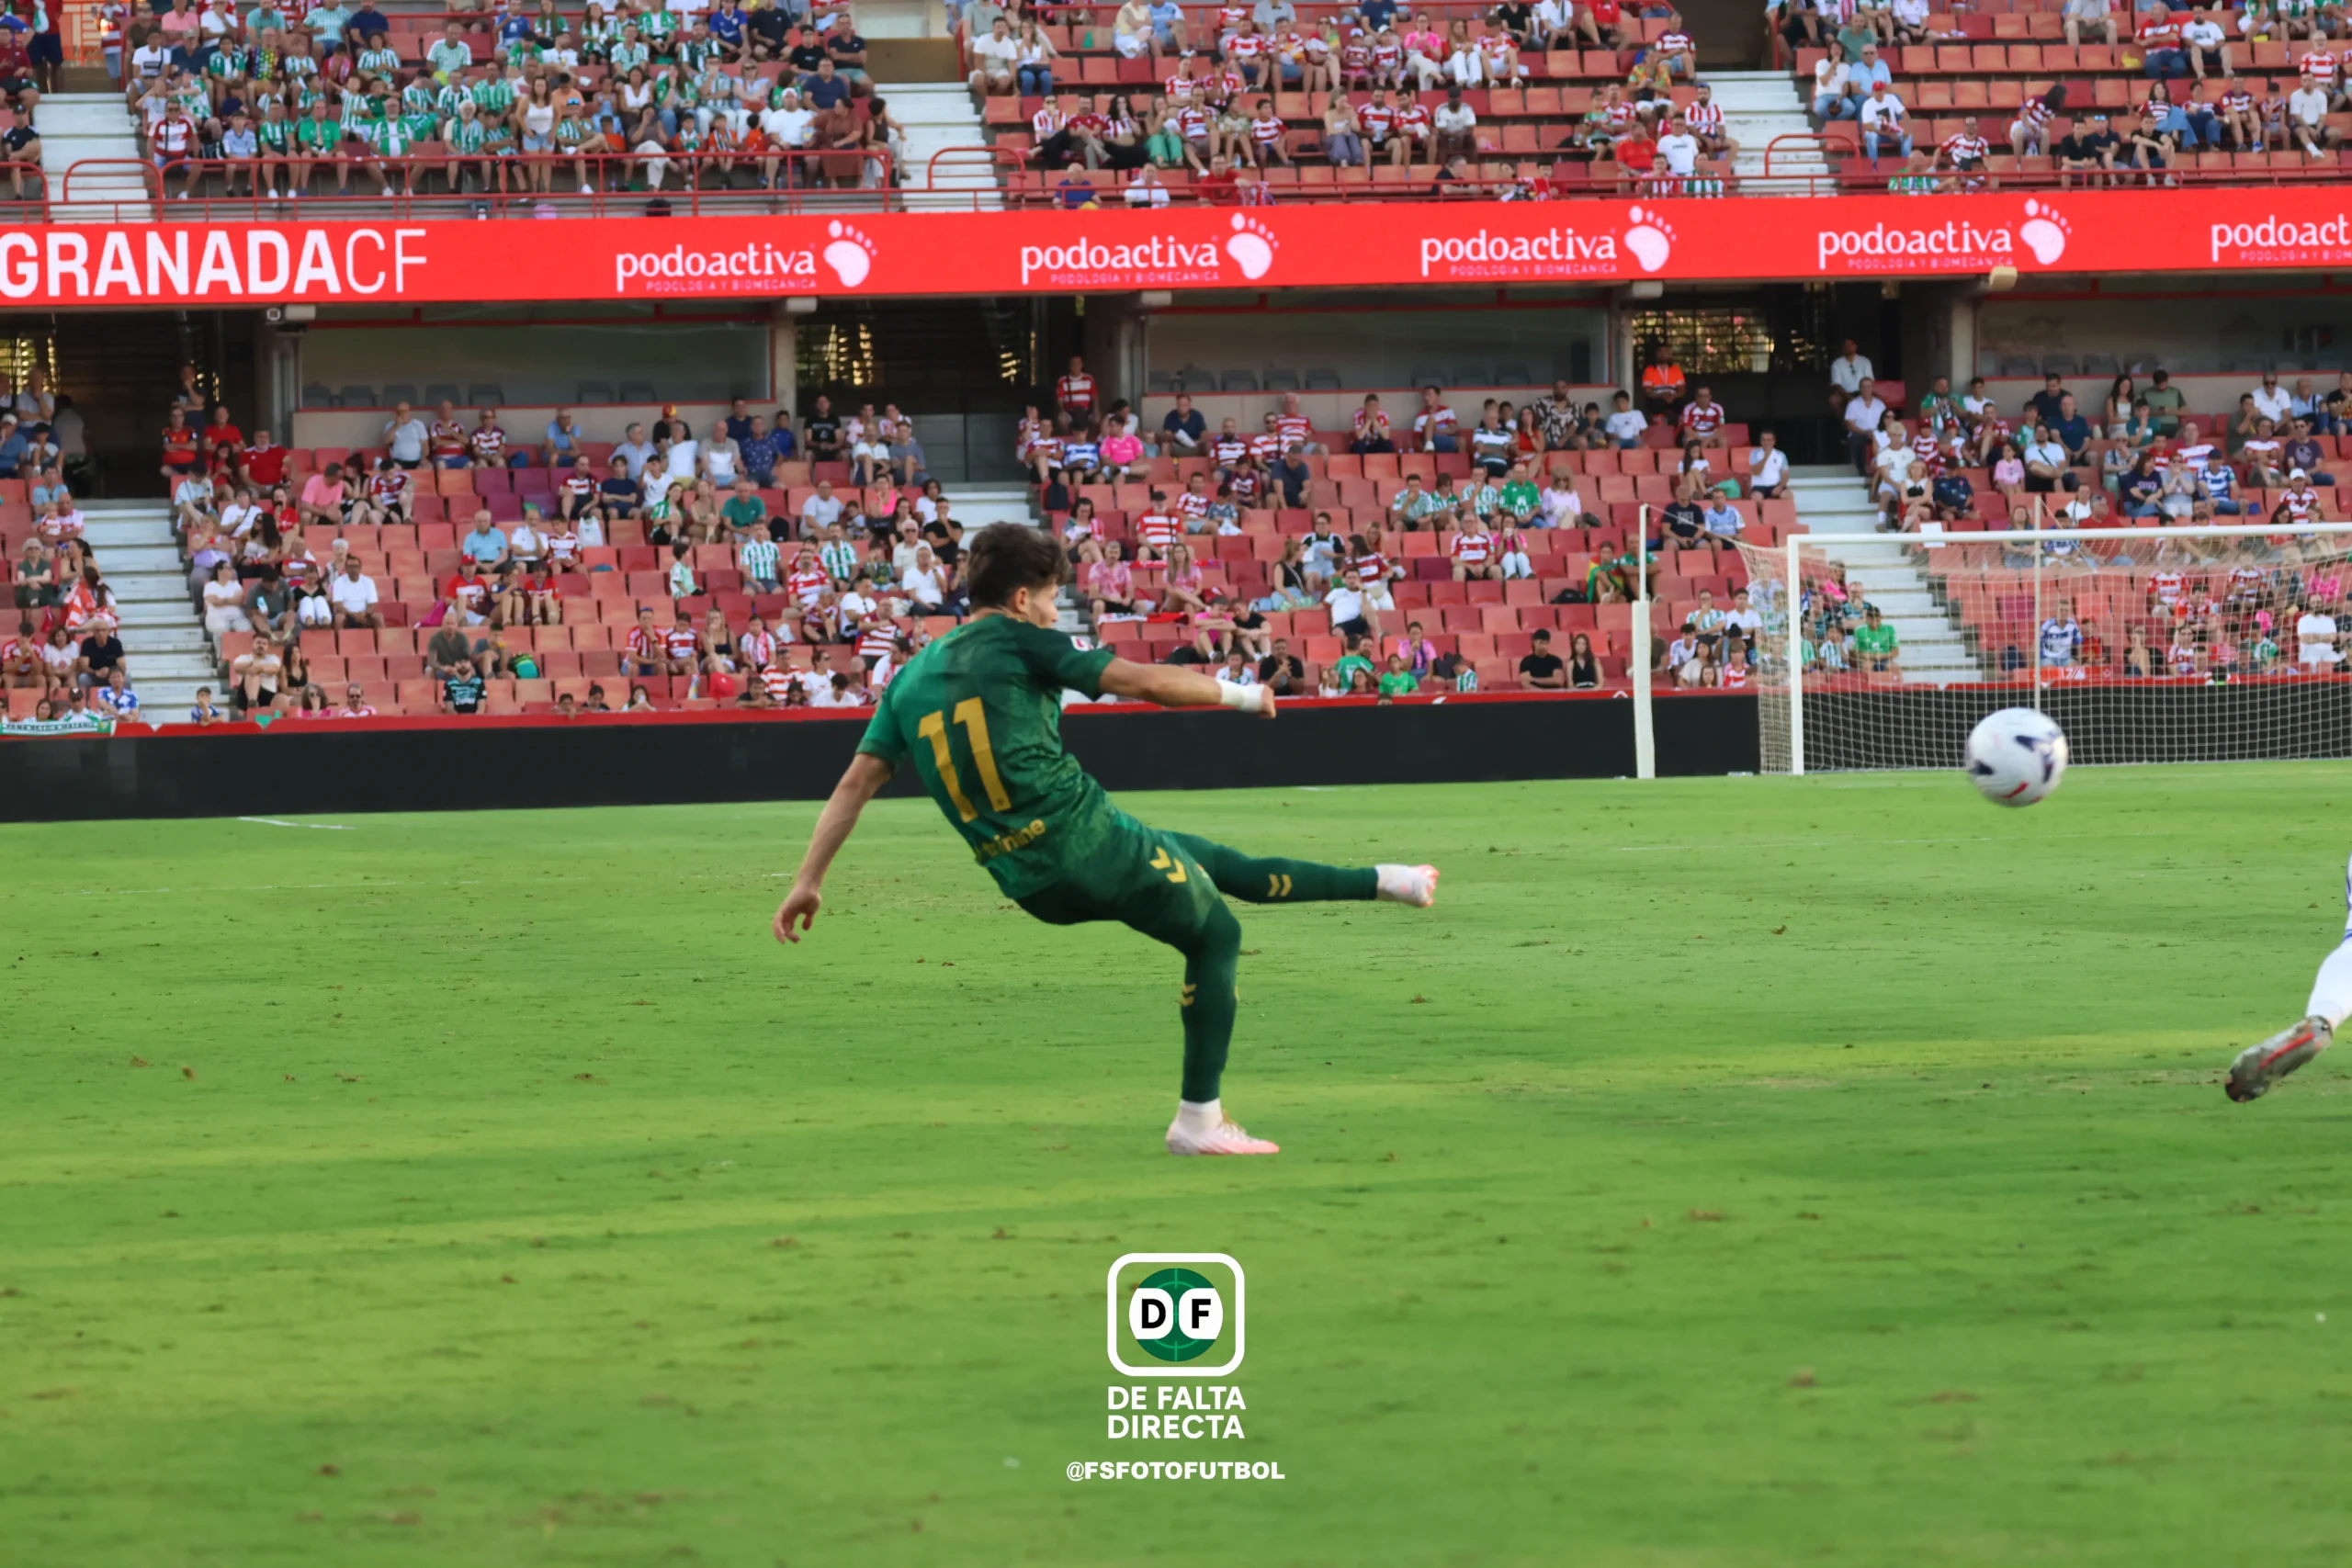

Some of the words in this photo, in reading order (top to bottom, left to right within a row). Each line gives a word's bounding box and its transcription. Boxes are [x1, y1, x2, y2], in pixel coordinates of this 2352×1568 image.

[1021, 234, 1220, 286] podoactiva
[1421, 227, 1617, 276] podoactiva
[1818, 220, 2013, 270] podoactiva
[1920, 258, 1927, 267] Y
[2211, 213, 2352, 263] podoact
[2312, 251, 2318, 260] Y
[616, 242, 816, 292] podoactiva
[720, 280, 728, 290] Y
[1124, 273, 1131, 283] Y
[1523, 265, 1530, 275] Y
[919, 697, 1011, 822] 11
